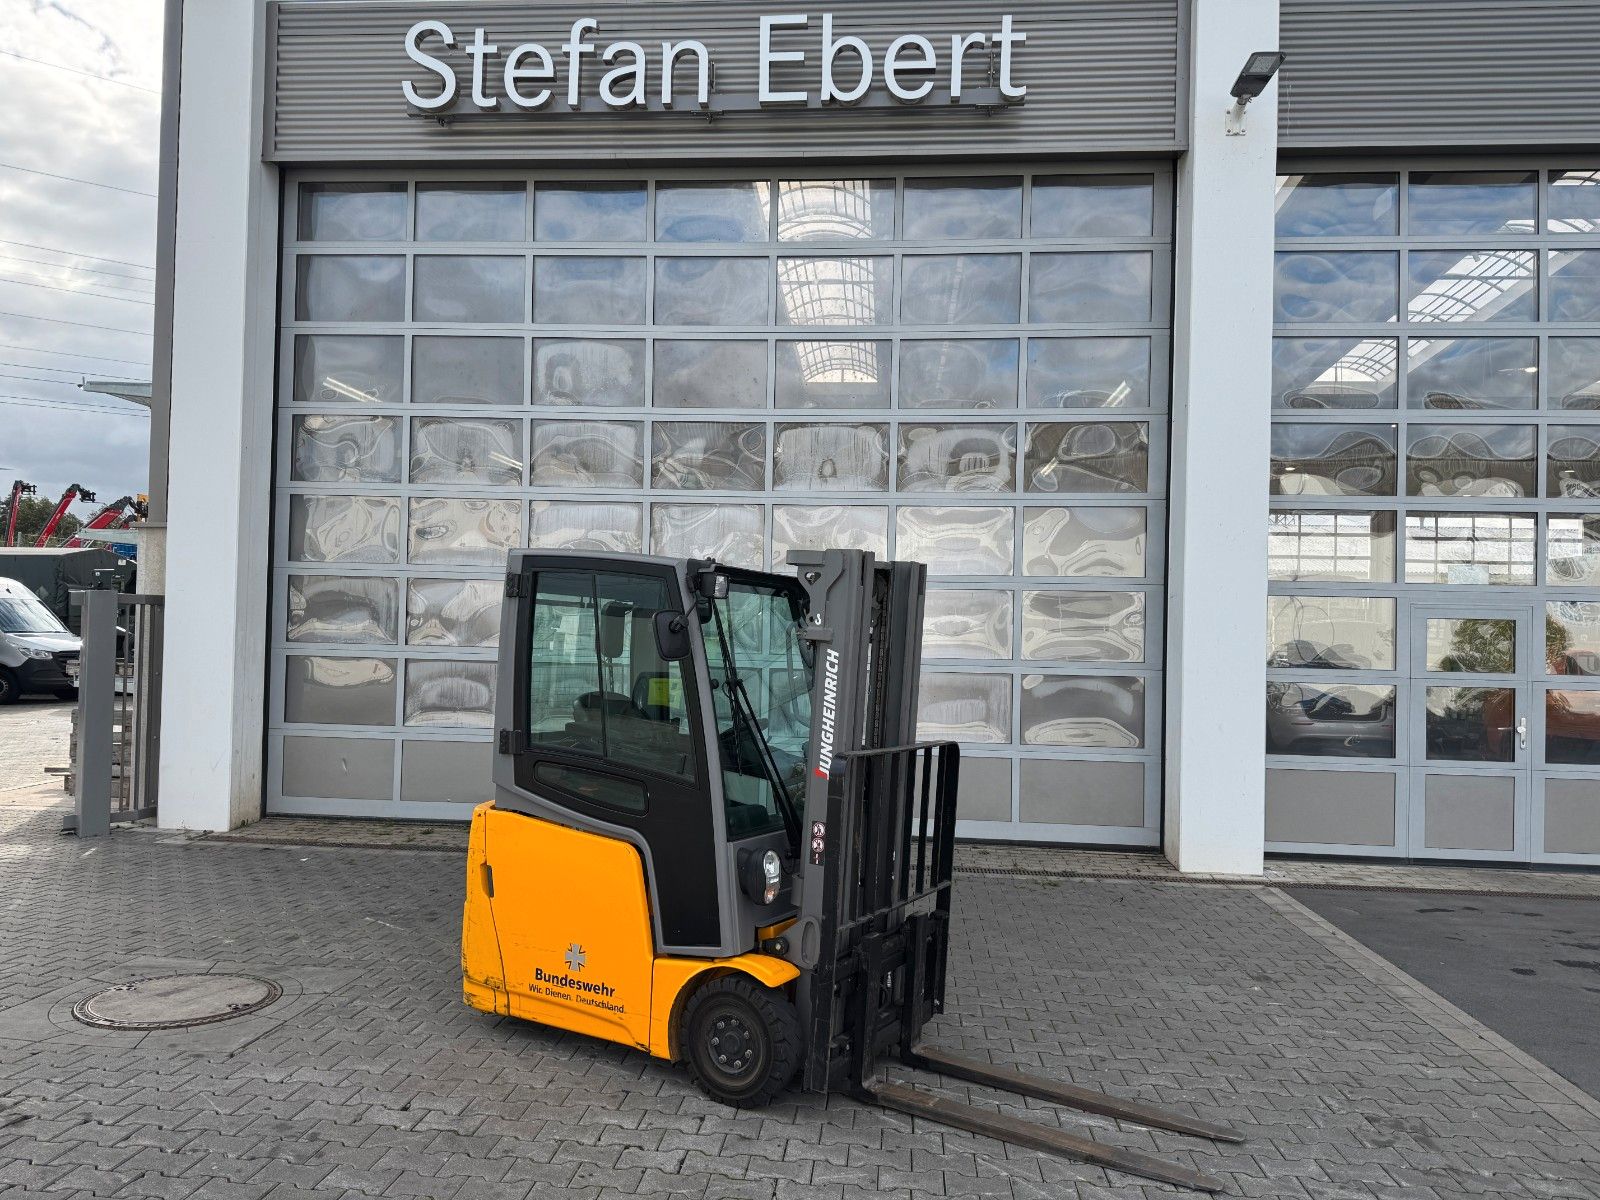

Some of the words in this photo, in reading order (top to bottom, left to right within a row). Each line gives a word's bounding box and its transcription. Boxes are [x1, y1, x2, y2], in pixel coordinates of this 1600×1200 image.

[401, 18, 709, 109] Stefan
[759, 13, 1027, 102] Ebert
[815, 648, 840, 780] JUNGHEINRICH
[535, 968, 615, 997] Bundeswehr
[575, 995, 624, 1013] Deutschland
